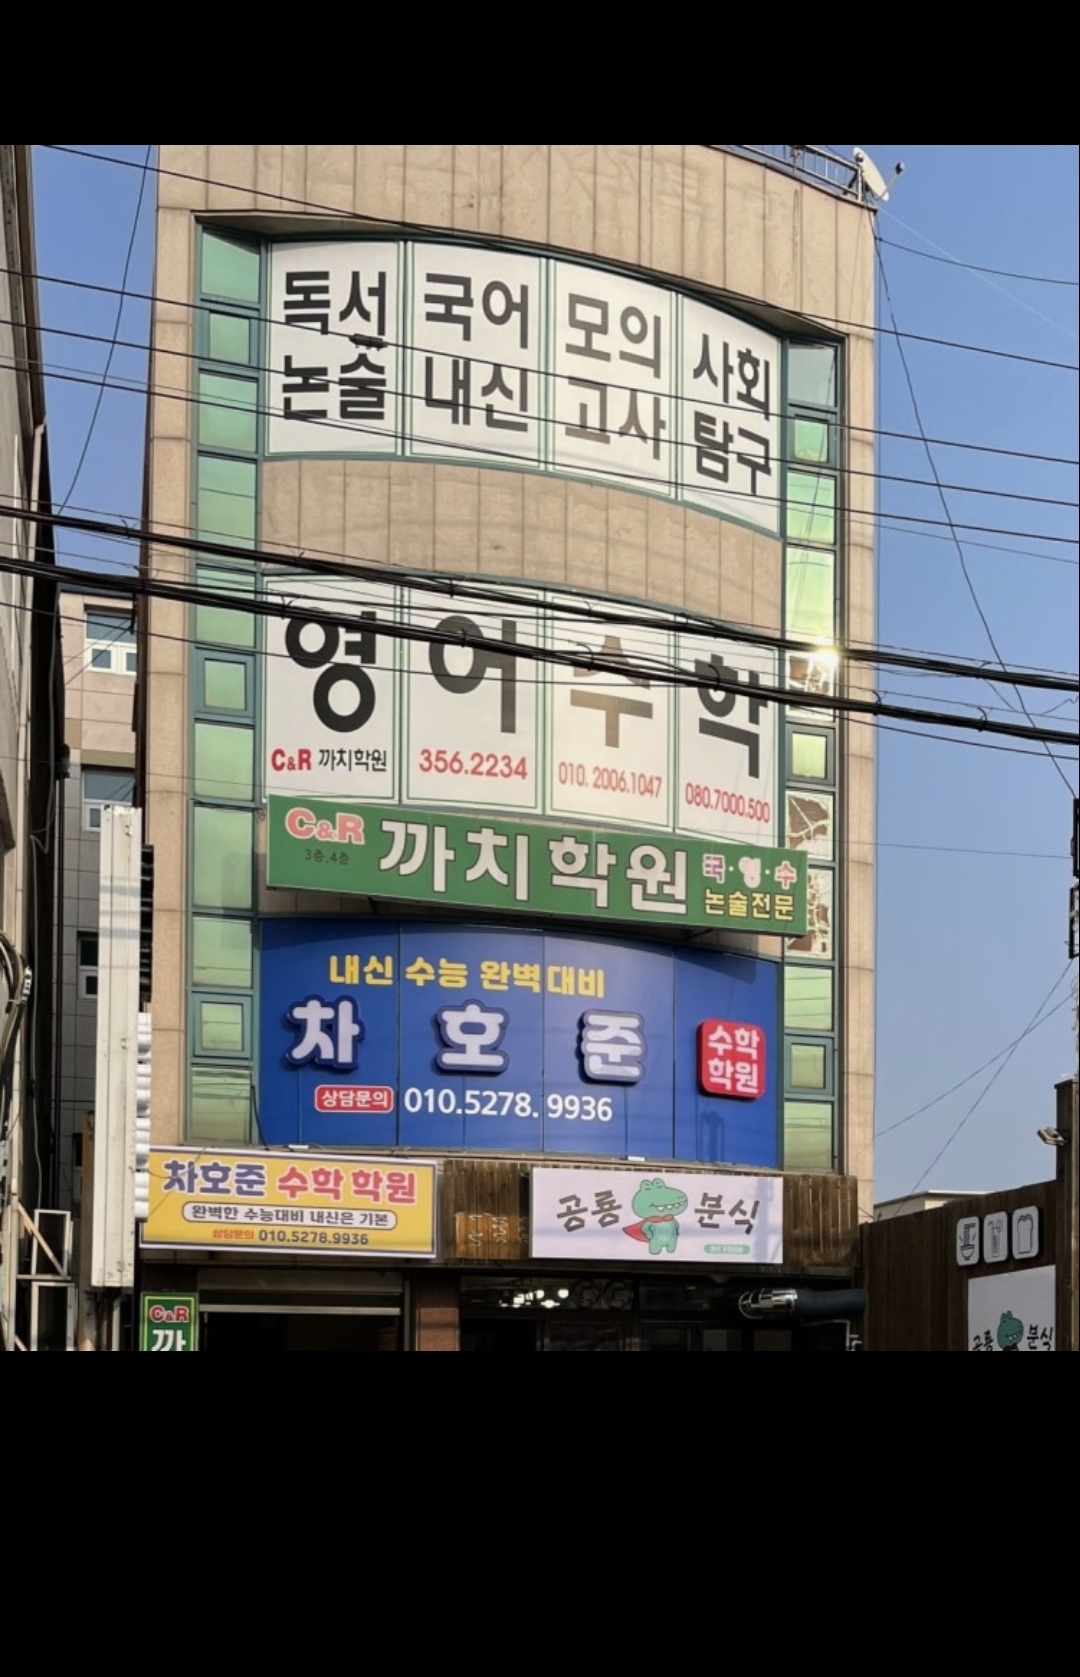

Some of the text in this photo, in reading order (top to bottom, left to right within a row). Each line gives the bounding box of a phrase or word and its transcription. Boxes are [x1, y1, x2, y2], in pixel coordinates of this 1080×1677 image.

[284, 270, 387, 336] 독서
[424, 273, 529, 349] 국어
[566, 293, 662, 378] 모의
[282, 352, 387, 420] 논술
[425, 357, 529, 432] 내신
[693, 333, 770, 420] 사회
[565, 375, 666, 459] 고사
[694, 410, 771, 495] 탐구
[271, 748, 387, 772] C&R 까치학원
[419, 749, 528, 780] 356.2234
[685, 783, 770, 823] 080.7000.500
[285, 807, 365, 845] C&R
[378, 820, 689, 915] 까치학원
[705, 888, 794, 921] 논술전문
[329, 955, 393, 986] 내신
[404, 957, 468, 989] 수능
[708, 1025, 760, 1060] 수학
[708, 1059, 760, 1095] 학원
[322, 1089, 389, 1108] 상담문의
[163, 1160, 416, 1204] 차호준 수학 학원
[191, 1205, 389, 1227] 완벽한 수능대비 내신은 기본
[556, 1190, 760, 1235] 공룡 분식
[212, 1228, 369, 1246] 상담문의 010.5278.9936
[151, 1306, 190, 1322] C&R
[1027, 1324, 1053, 1351] 분식
